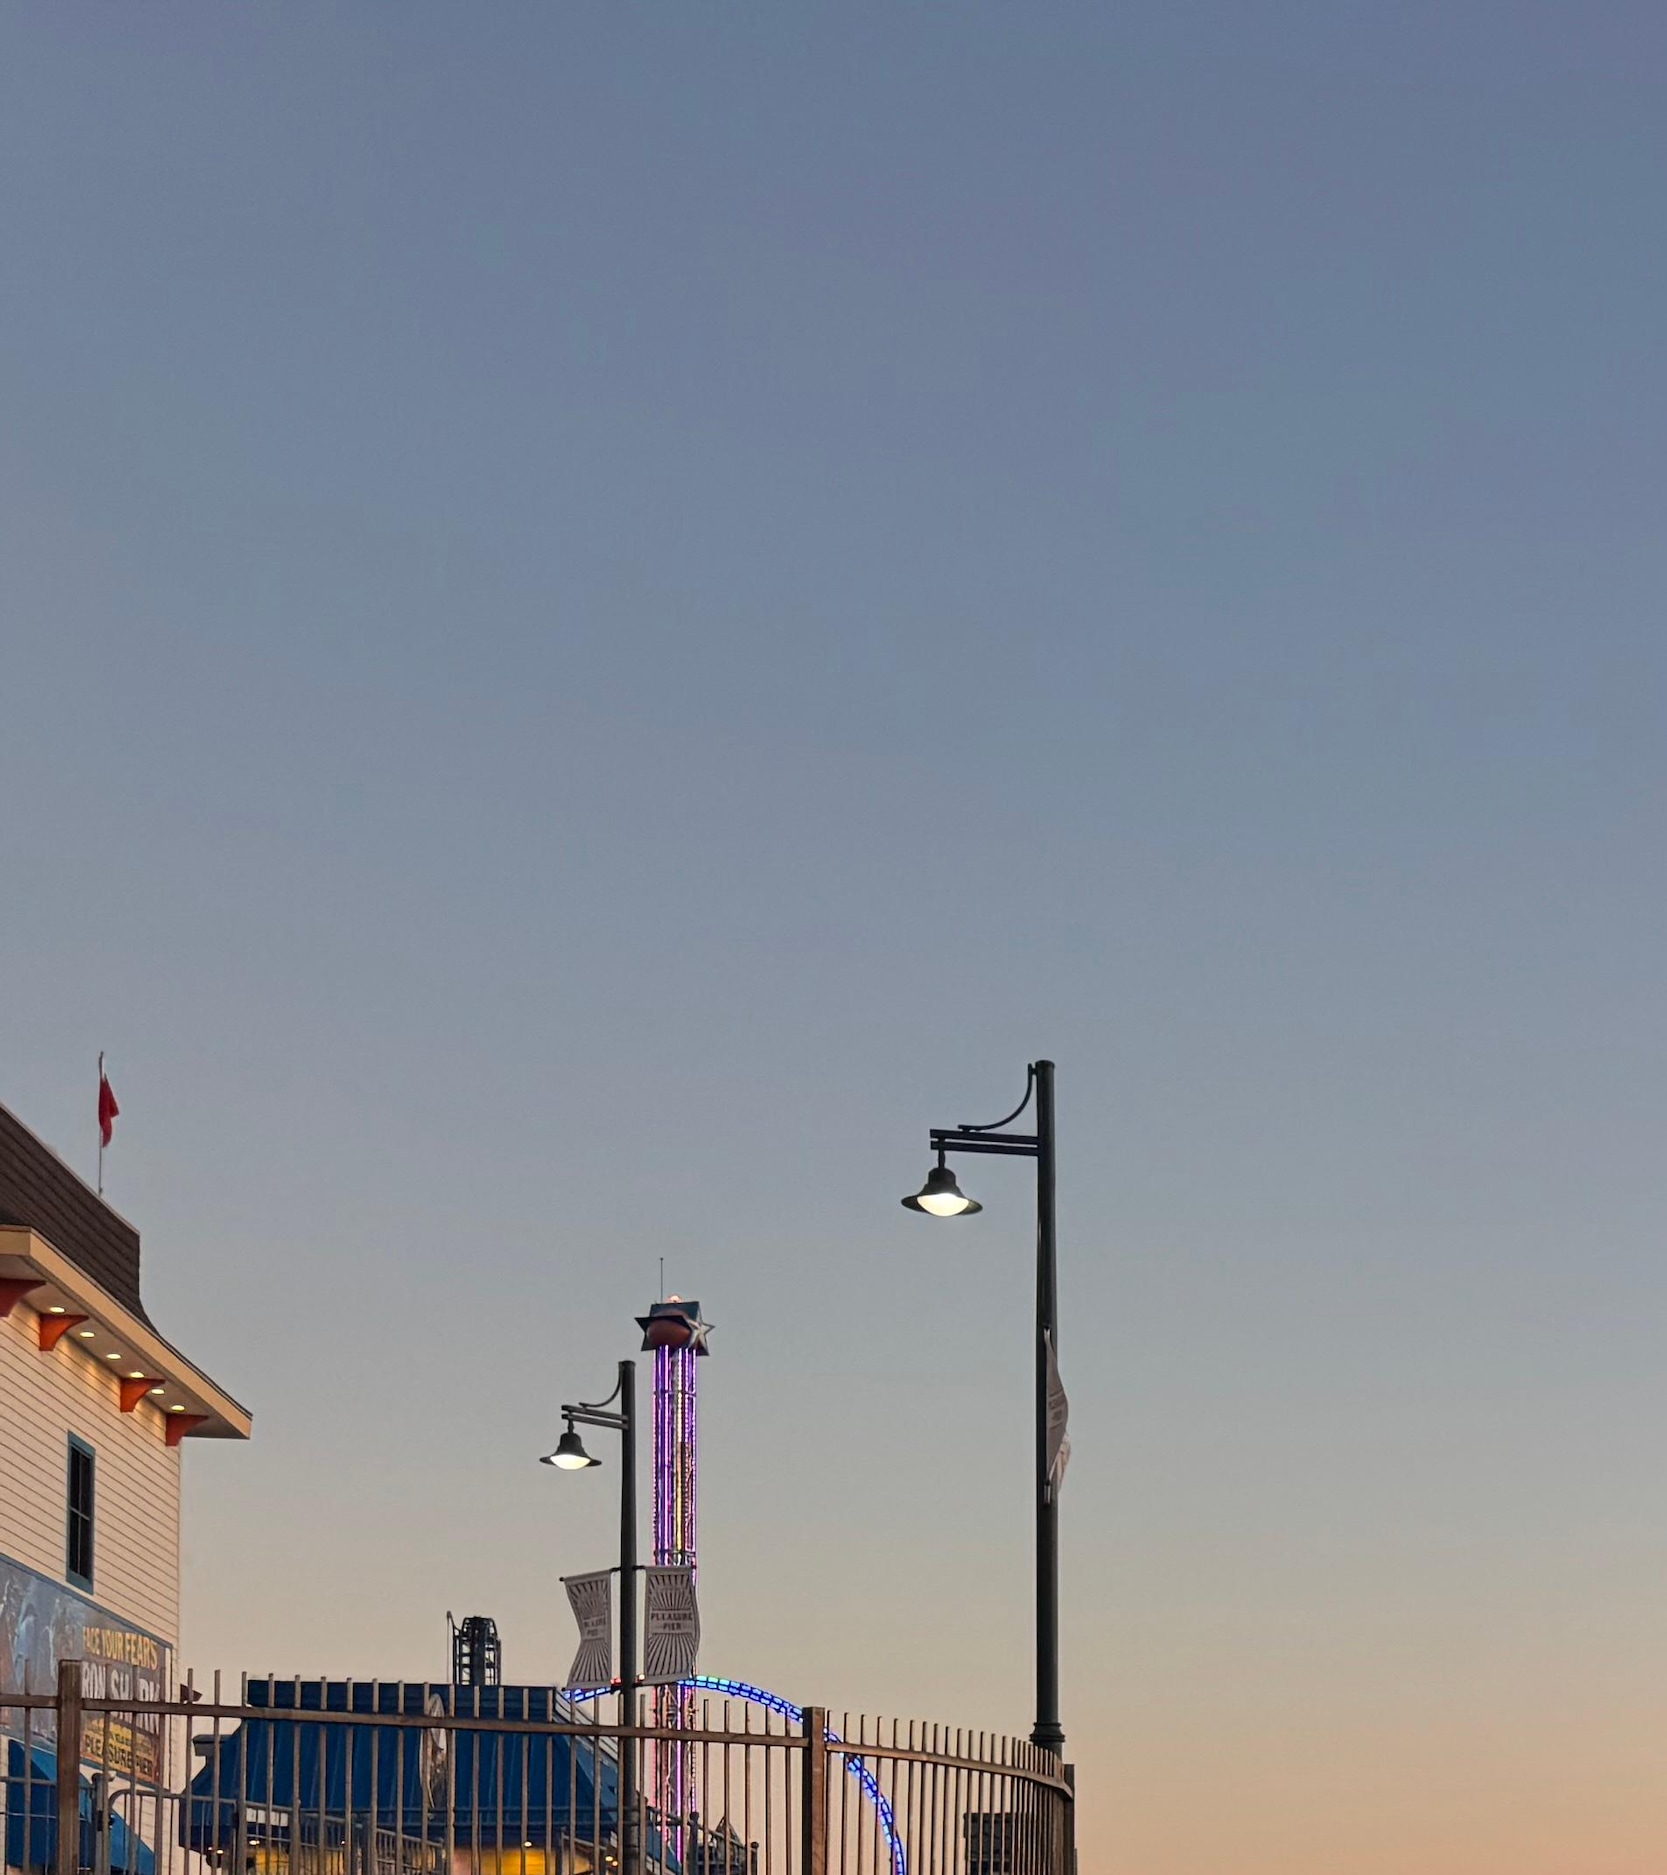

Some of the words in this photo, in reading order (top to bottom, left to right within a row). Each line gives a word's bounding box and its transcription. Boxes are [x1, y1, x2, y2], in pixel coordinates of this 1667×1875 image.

[102, 1629, 125, 1661] YOUR
[125, 1632, 159, 1671] FEARS
[85, 1734, 133, 1769] PLESURE
